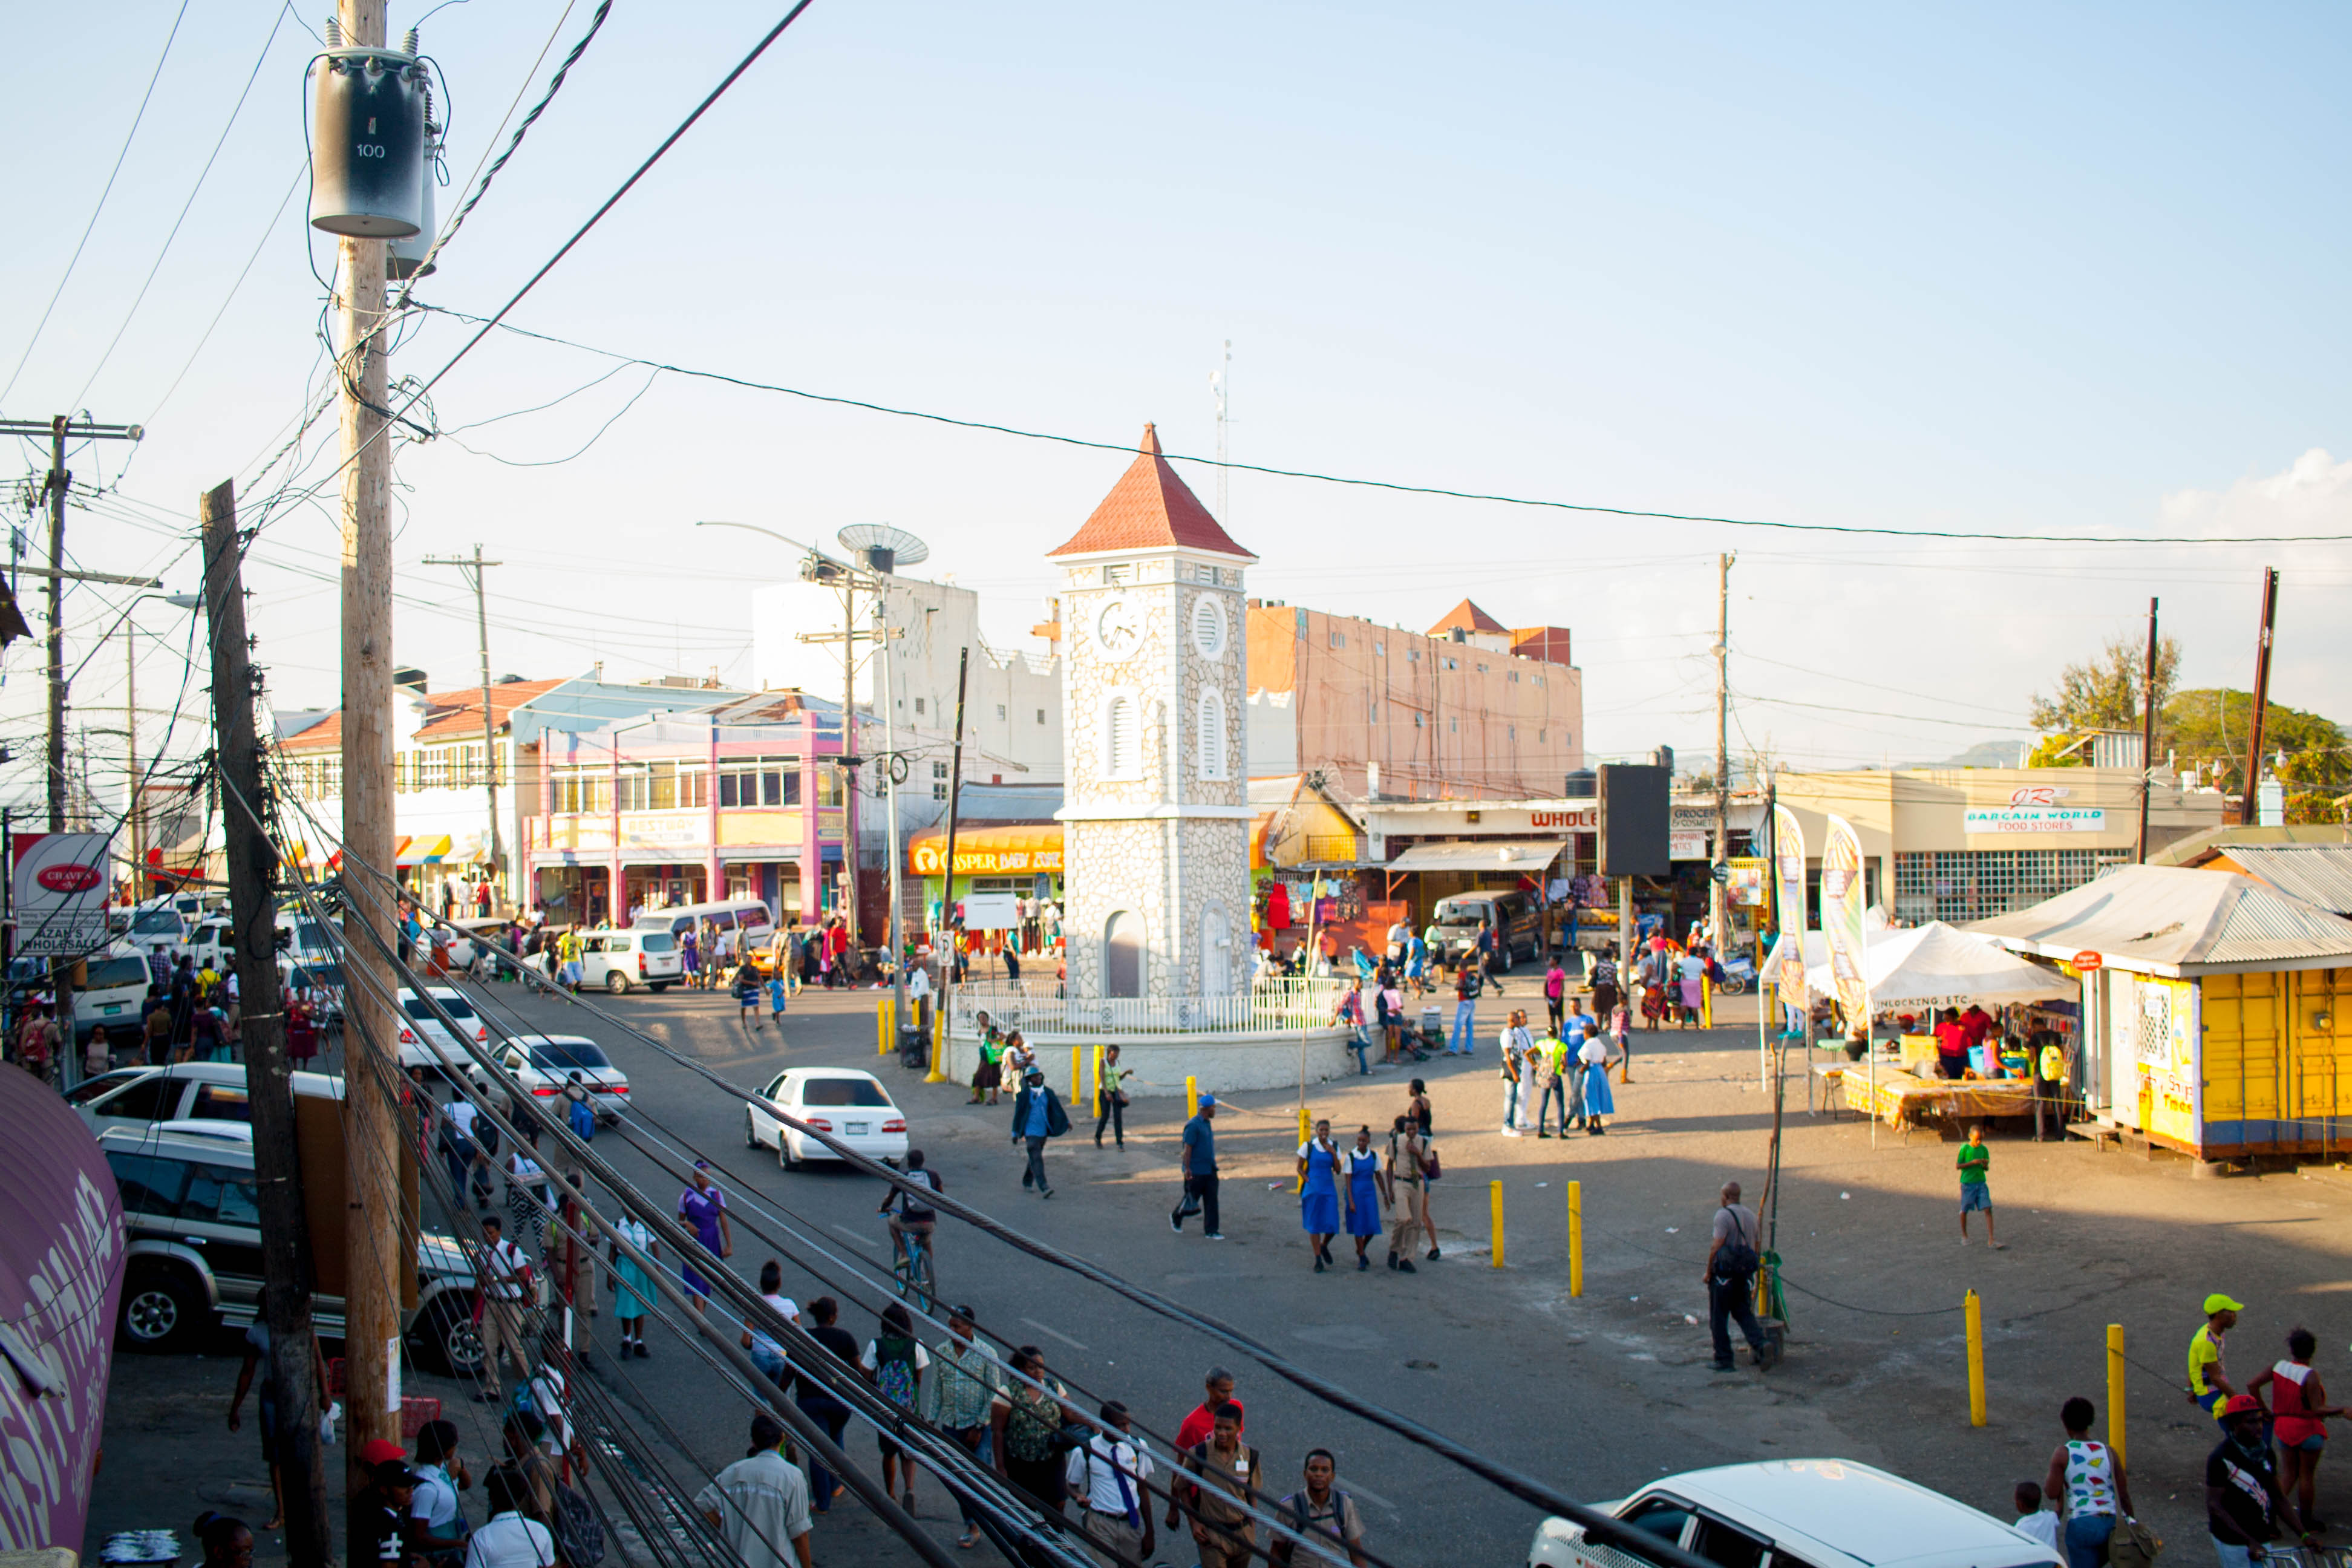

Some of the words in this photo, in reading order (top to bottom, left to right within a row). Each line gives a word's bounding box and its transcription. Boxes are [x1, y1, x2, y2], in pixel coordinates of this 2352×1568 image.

[356, 144, 385, 158] 100
[1674, 808, 1716, 818] GROCER
[1967, 812, 2040, 821] BARGAIN
[2047, 810, 2102, 819] WORLD
[1532, 812, 1596, 826] WHOLE
[629, 818, 695, 832] BESTWAY
[1998, 822, 2027, 831] FOOD
[2031, 821, 2073, 831] STORES
[47, 871, 93, 881] CRAVEN
[21, 939, 99, 949] WHOLESALE
